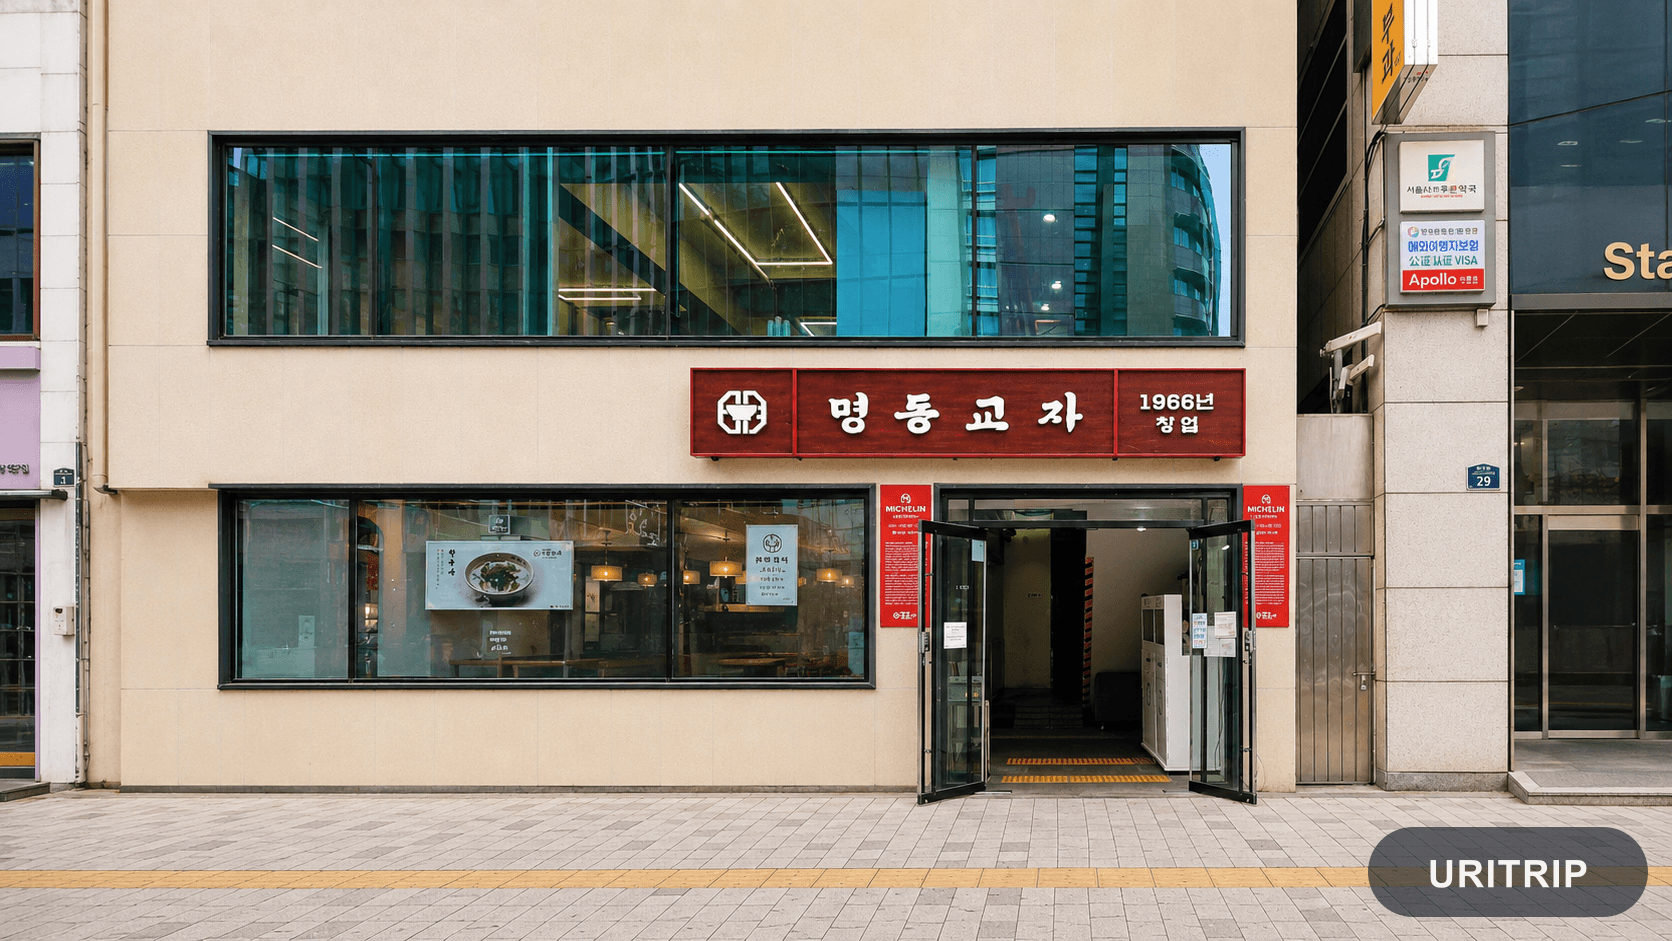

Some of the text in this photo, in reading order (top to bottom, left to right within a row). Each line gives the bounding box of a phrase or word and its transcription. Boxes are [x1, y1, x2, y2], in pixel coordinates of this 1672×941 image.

[1455, 255, 1478, 265] VISA
[1603, 241, 1672, 281] Sta
[1408, 272, 1457, 289] Apollo
[1140, 392, 1214, 411] 1966년
[828, 391, 1084, 434] 명동교자
[1156, 416, 1199, 434] 창업
[1476, 476, 1491, 487] 29
